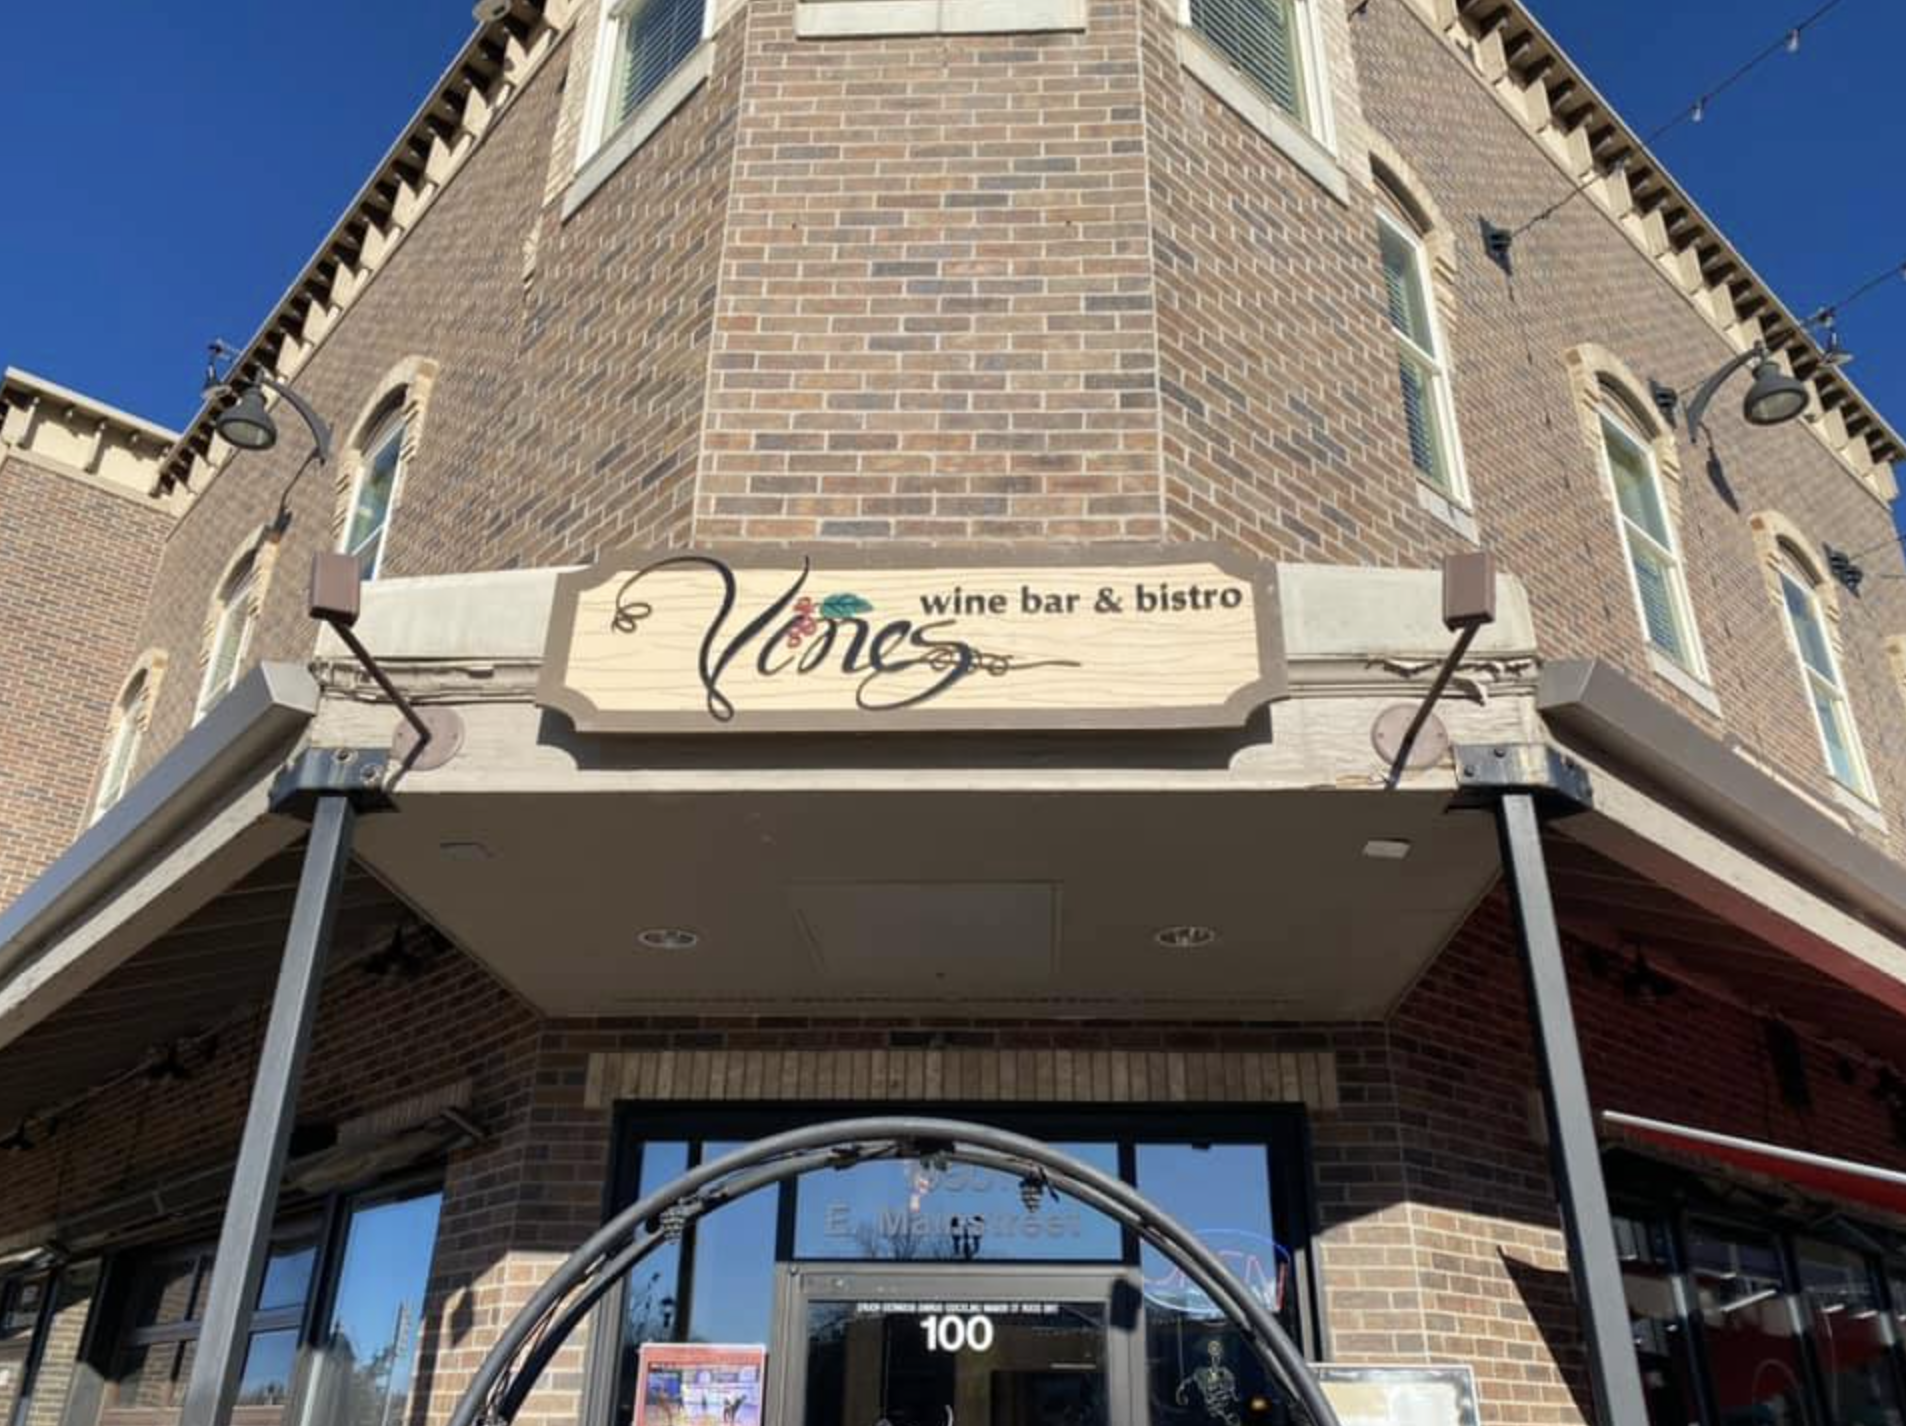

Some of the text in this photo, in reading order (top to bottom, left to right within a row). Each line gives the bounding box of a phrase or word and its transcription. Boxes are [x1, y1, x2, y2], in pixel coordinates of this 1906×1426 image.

[919, 583, 1243, 615] wine bar & bistro
[612, 556, 1080, 722] Vines
[919, 1314, 994, 1352] 100
